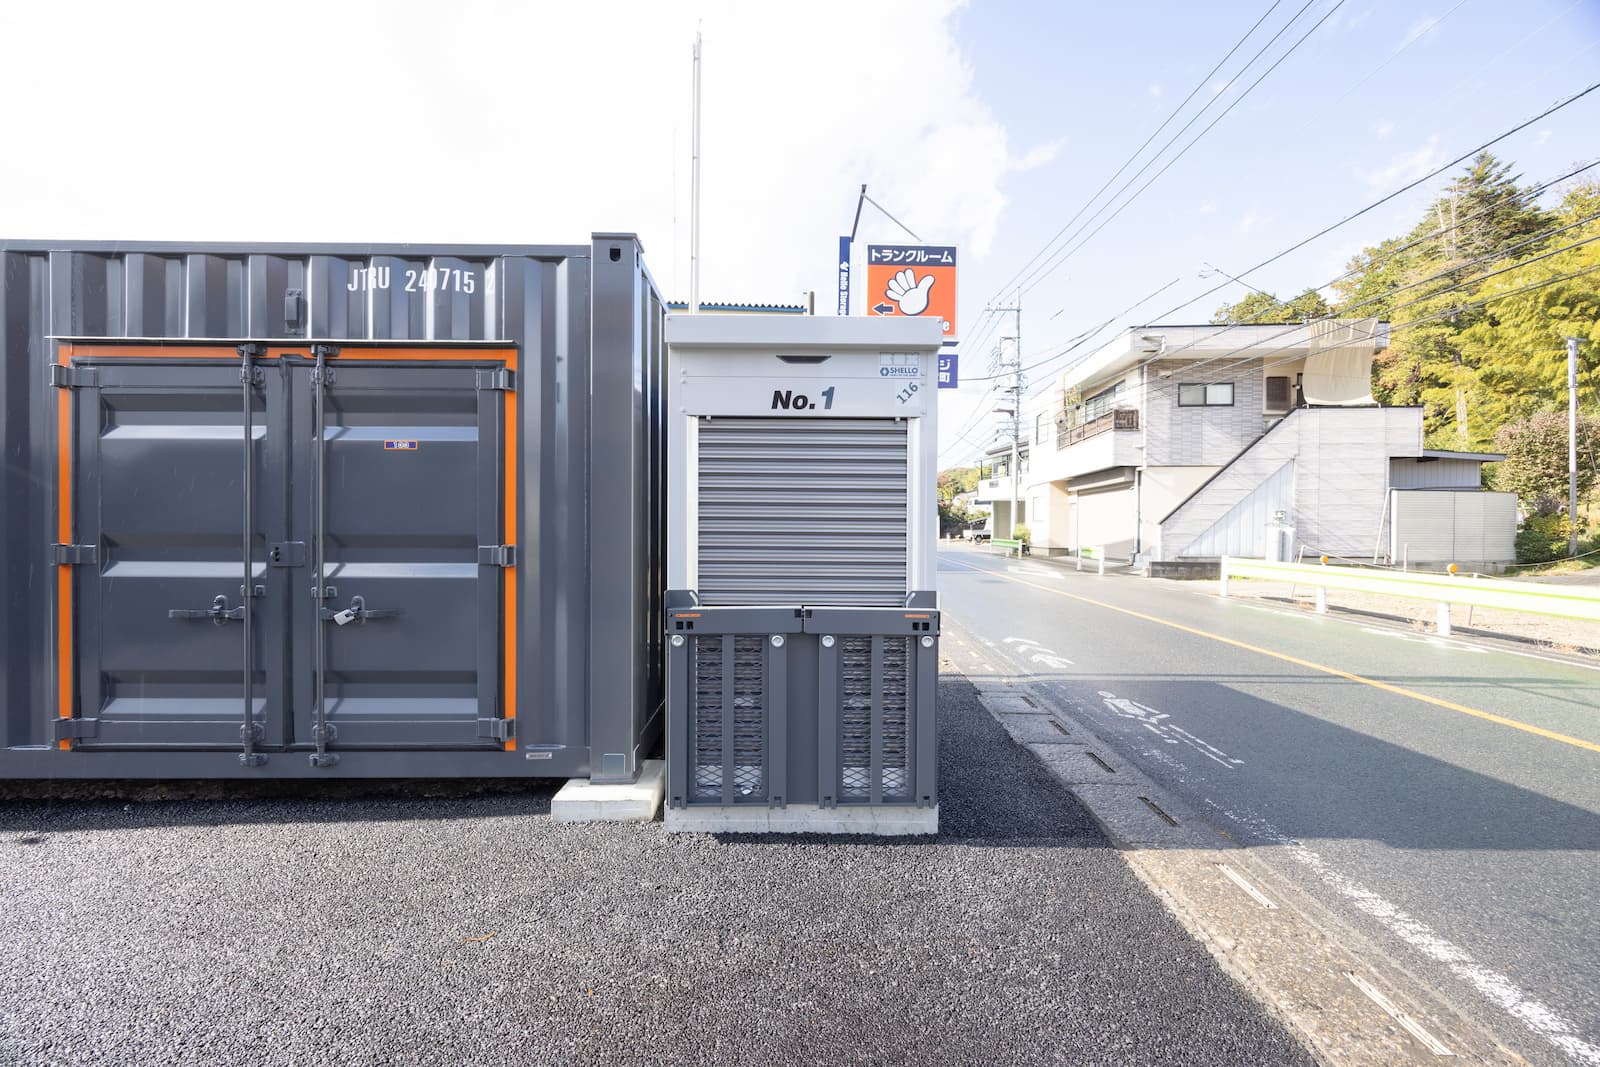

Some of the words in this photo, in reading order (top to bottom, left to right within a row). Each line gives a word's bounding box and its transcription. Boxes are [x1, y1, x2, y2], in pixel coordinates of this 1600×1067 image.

[871, 248, 953, 263] トランクルーム
[771, 390, 816, 410] No.
[821, 386, 835, 410] 1
[896, 382, 919, 404] 116
